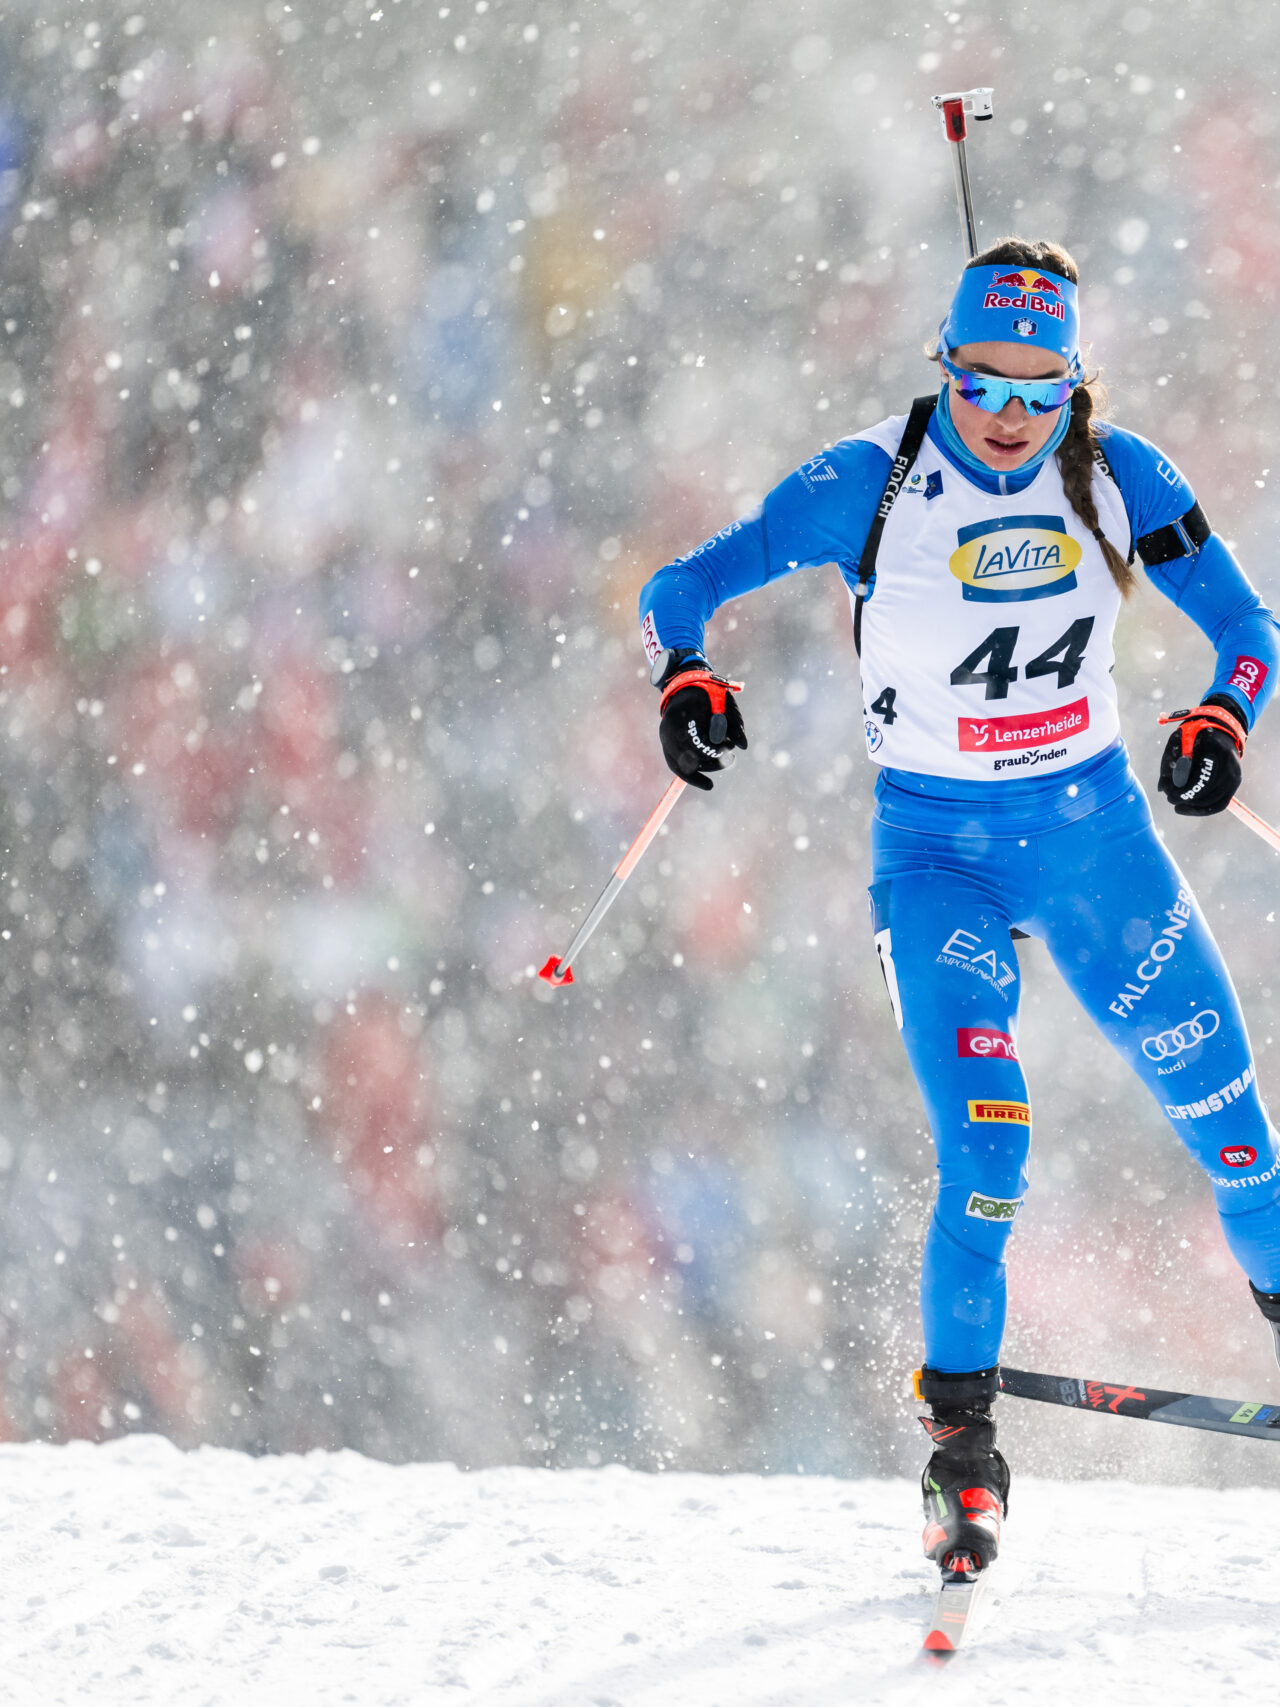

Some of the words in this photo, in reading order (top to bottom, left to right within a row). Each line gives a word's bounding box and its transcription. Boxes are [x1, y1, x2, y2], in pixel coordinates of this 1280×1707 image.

[983, 292, 1028, 309] Red
[1029, 294, 1065, 322] Bull
[877, 455, 909, 518] FIOCCHI
[950, 616, 1095, 701] 44
[1231, 661, 1259, 701] enel
[688, 719, 725, 759] sportfu
[994, 711, 1083, 743] Lenzerheide
[1180, 757, 1214, 800] sportful
[936, 954, 981, 975] EMPORIO
[1157, 1059, 1187, 1076] Audi
